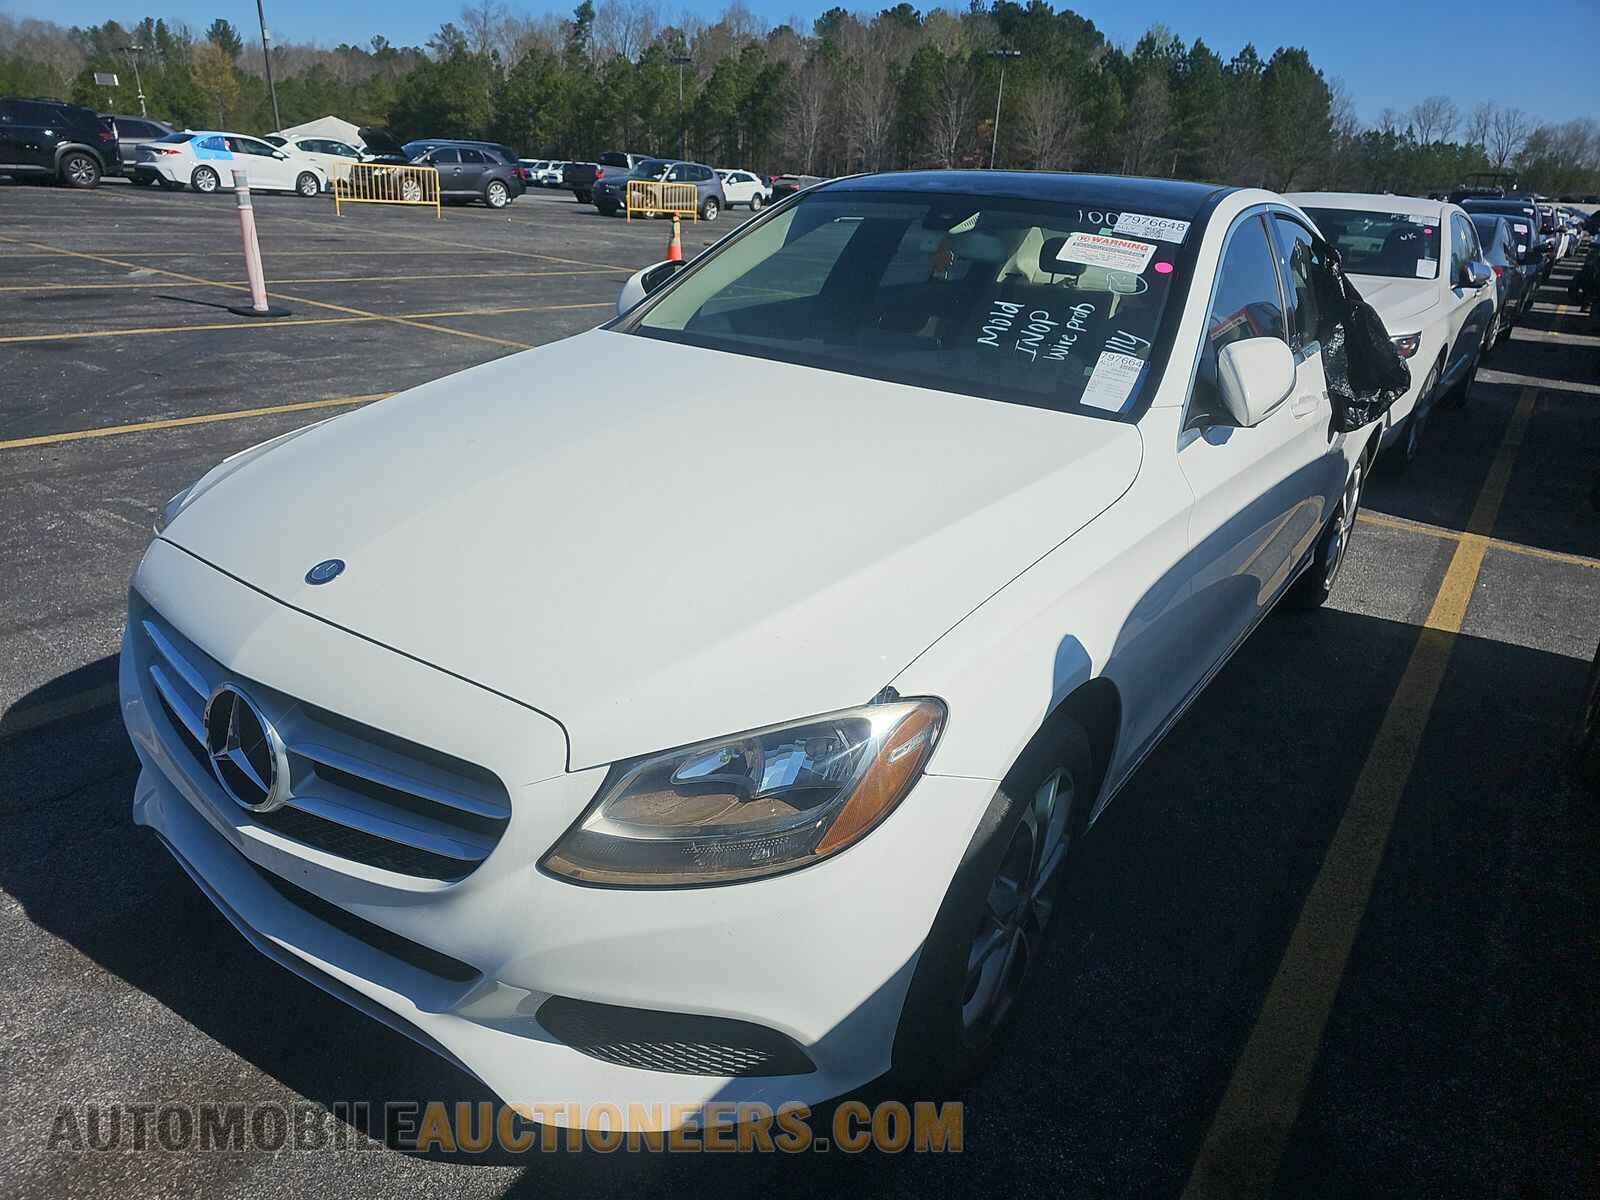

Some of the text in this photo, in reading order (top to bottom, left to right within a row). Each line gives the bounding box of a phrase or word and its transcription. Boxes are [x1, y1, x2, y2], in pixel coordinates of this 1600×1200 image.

[1121, 213, 1186, 232] 7976648
[1091, 236, 1149, 252] WARNING
[1100, 351, 1143, 368] 797664
